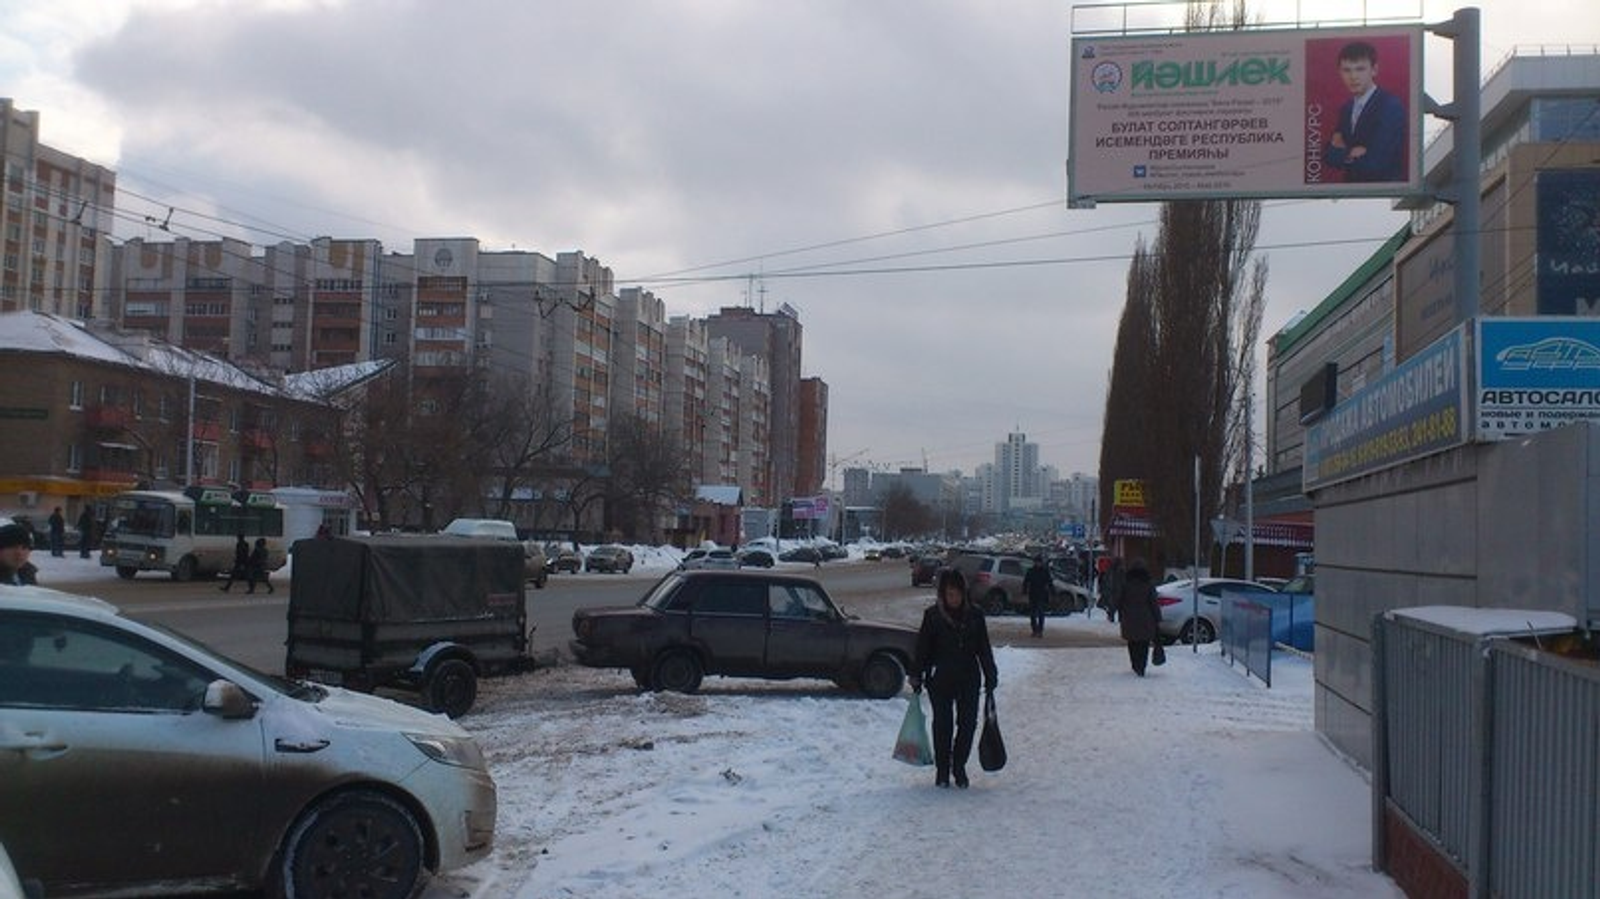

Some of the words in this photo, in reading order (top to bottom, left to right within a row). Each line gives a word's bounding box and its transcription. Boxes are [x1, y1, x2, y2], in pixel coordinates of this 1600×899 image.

[1111, 121, 1154, 134] БУЛАТ
[1157, 117, 1269, 133] СОЛТАНГӘРӘЕВ
[1095, 134, 1188, 149] ИСЕМЕНДӘГЕ
[1191, 131, 1285, 145] РЕСПУБЛИКА
[1307, 104, 1322, 183] КОНКУРС
[1360, 344, 1455, 431] АВТОМОБИЛЕЙ
[1481, 410, 1522, 419] новые
[1526, 410, 1535, 418] и
